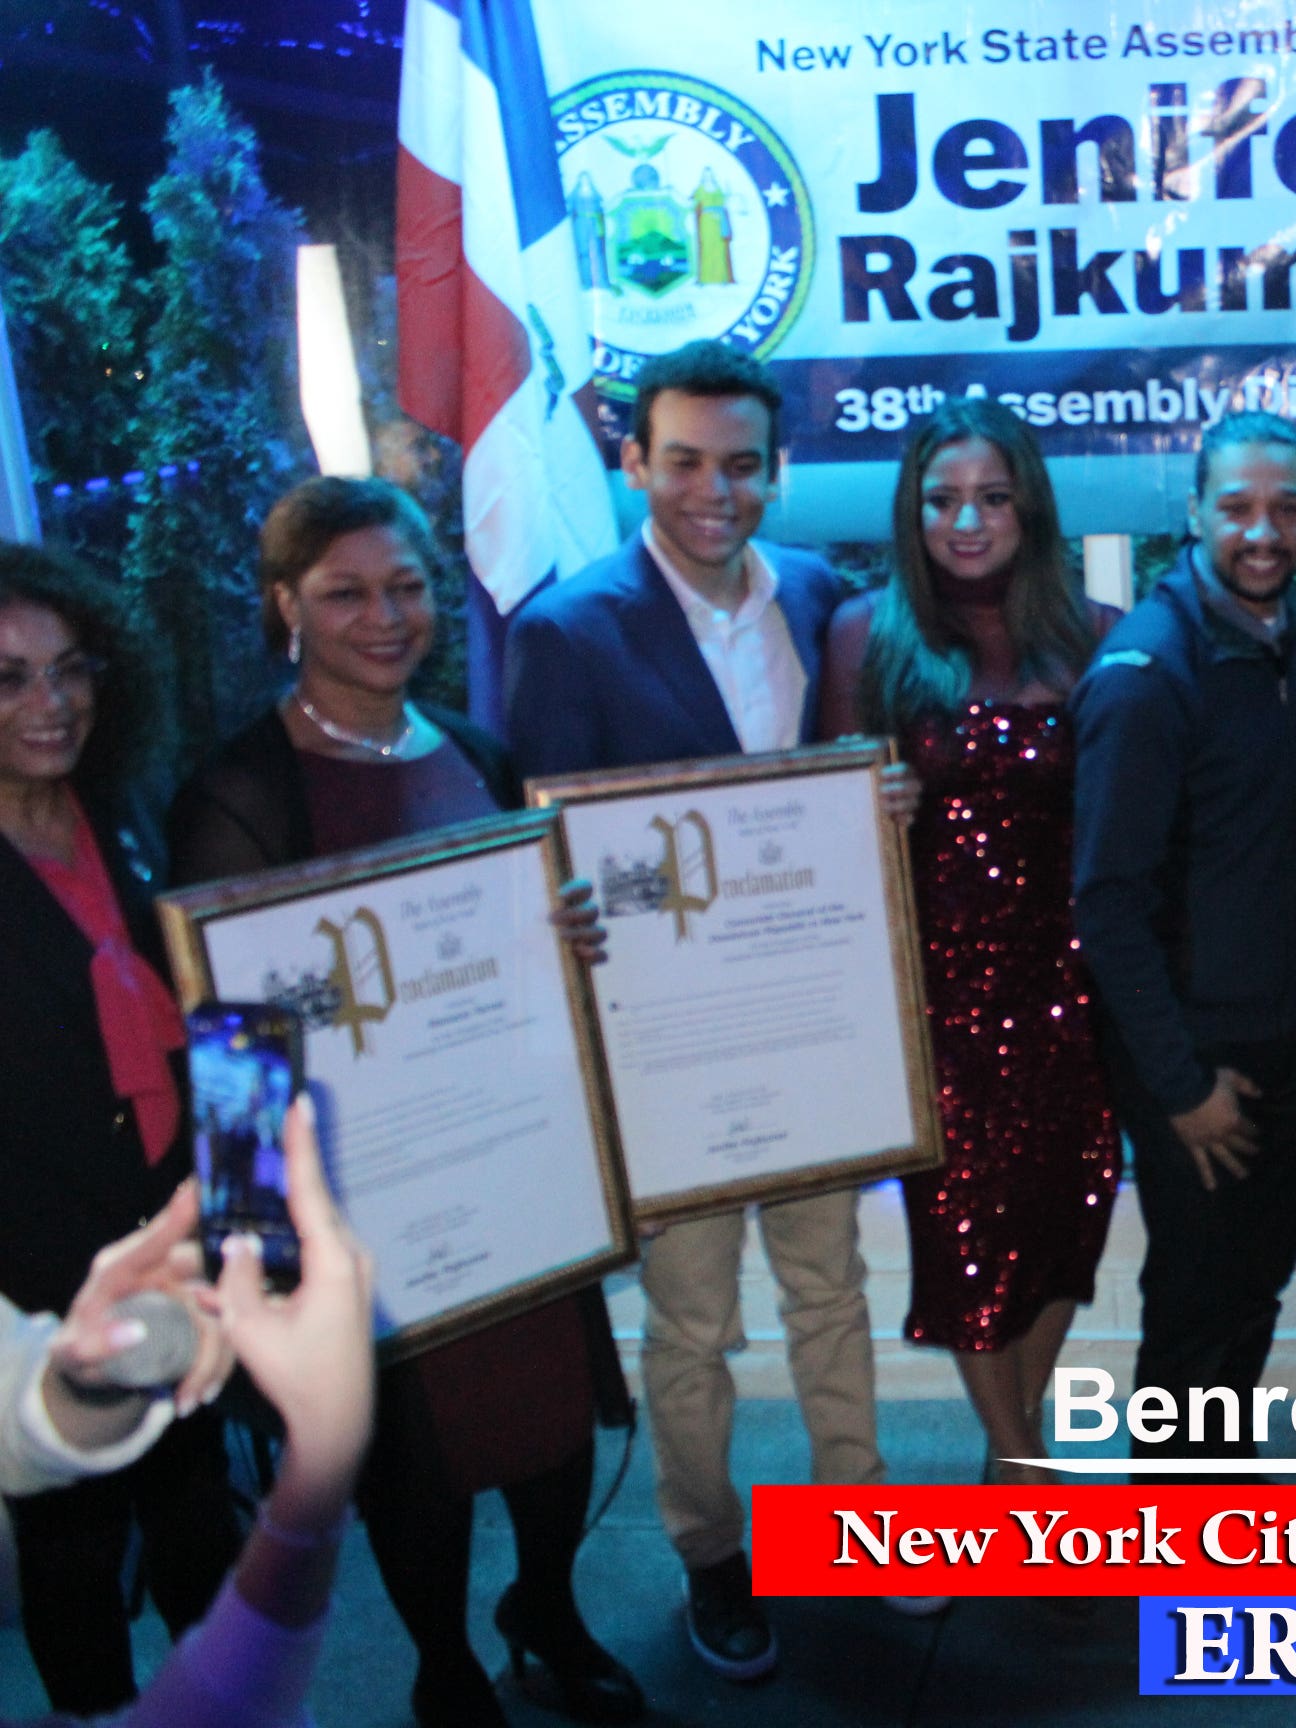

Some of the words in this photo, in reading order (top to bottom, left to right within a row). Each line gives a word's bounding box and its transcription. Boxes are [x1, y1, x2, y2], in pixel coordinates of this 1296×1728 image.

[756, 38, 852, 72] New
[863, 31, 969, 68] York
[982, 28, 1108, 64] State
[555, 89, 757, 153] SSEMBLY
[731, 246, 798, 343] YORK
[835, 383, 946, 432] 38th
